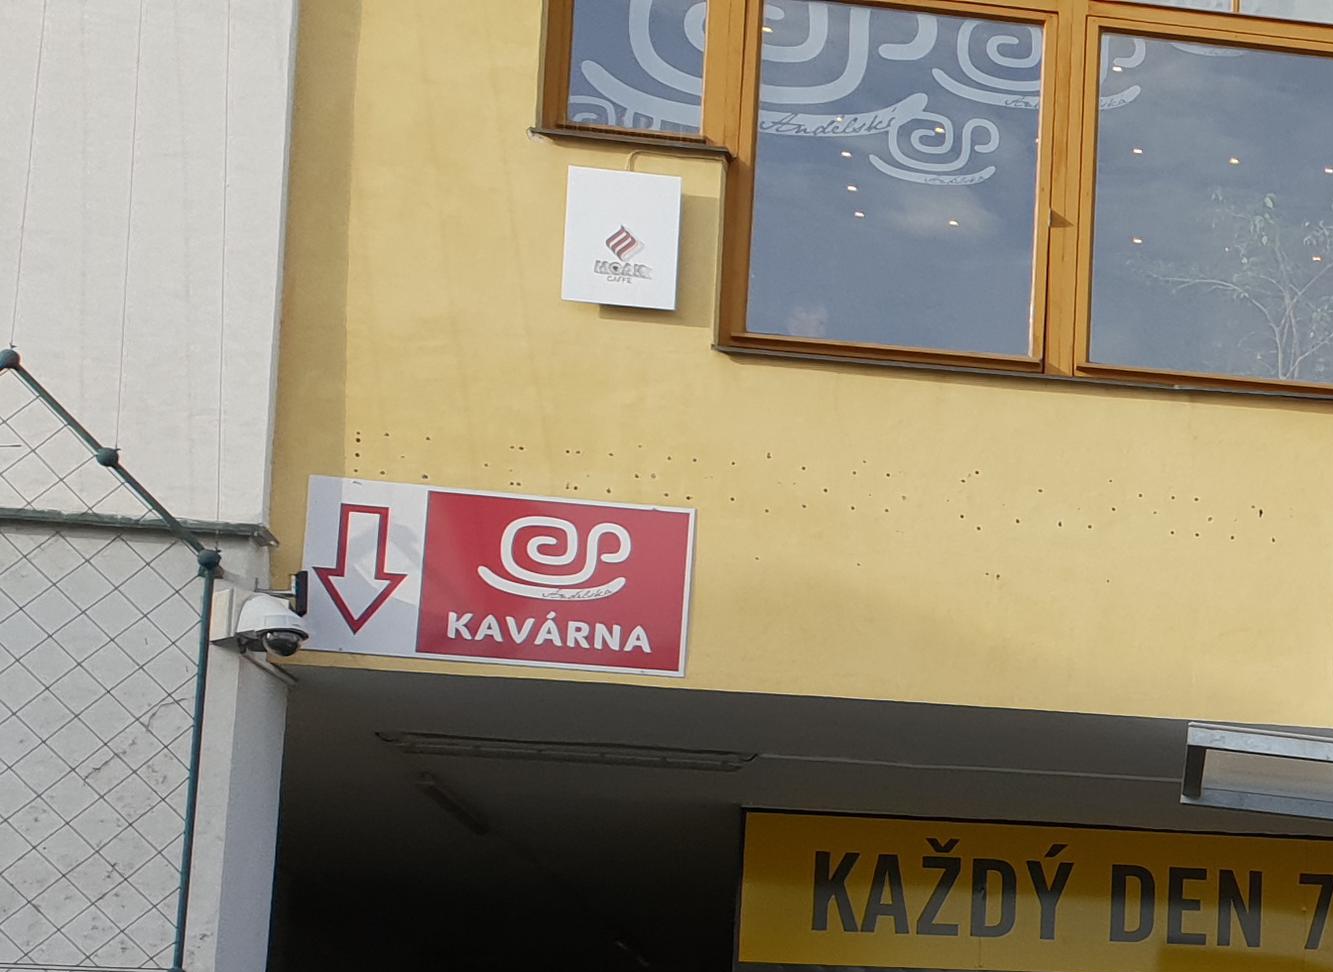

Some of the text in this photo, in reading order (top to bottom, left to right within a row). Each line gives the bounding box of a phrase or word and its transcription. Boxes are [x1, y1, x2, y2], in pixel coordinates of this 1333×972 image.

[447, 611, 652, 653] KAVÁRNA
[811, 838, 1075, 941] KAŽDÝ
[1109, 864, 1262, 947] DEN
